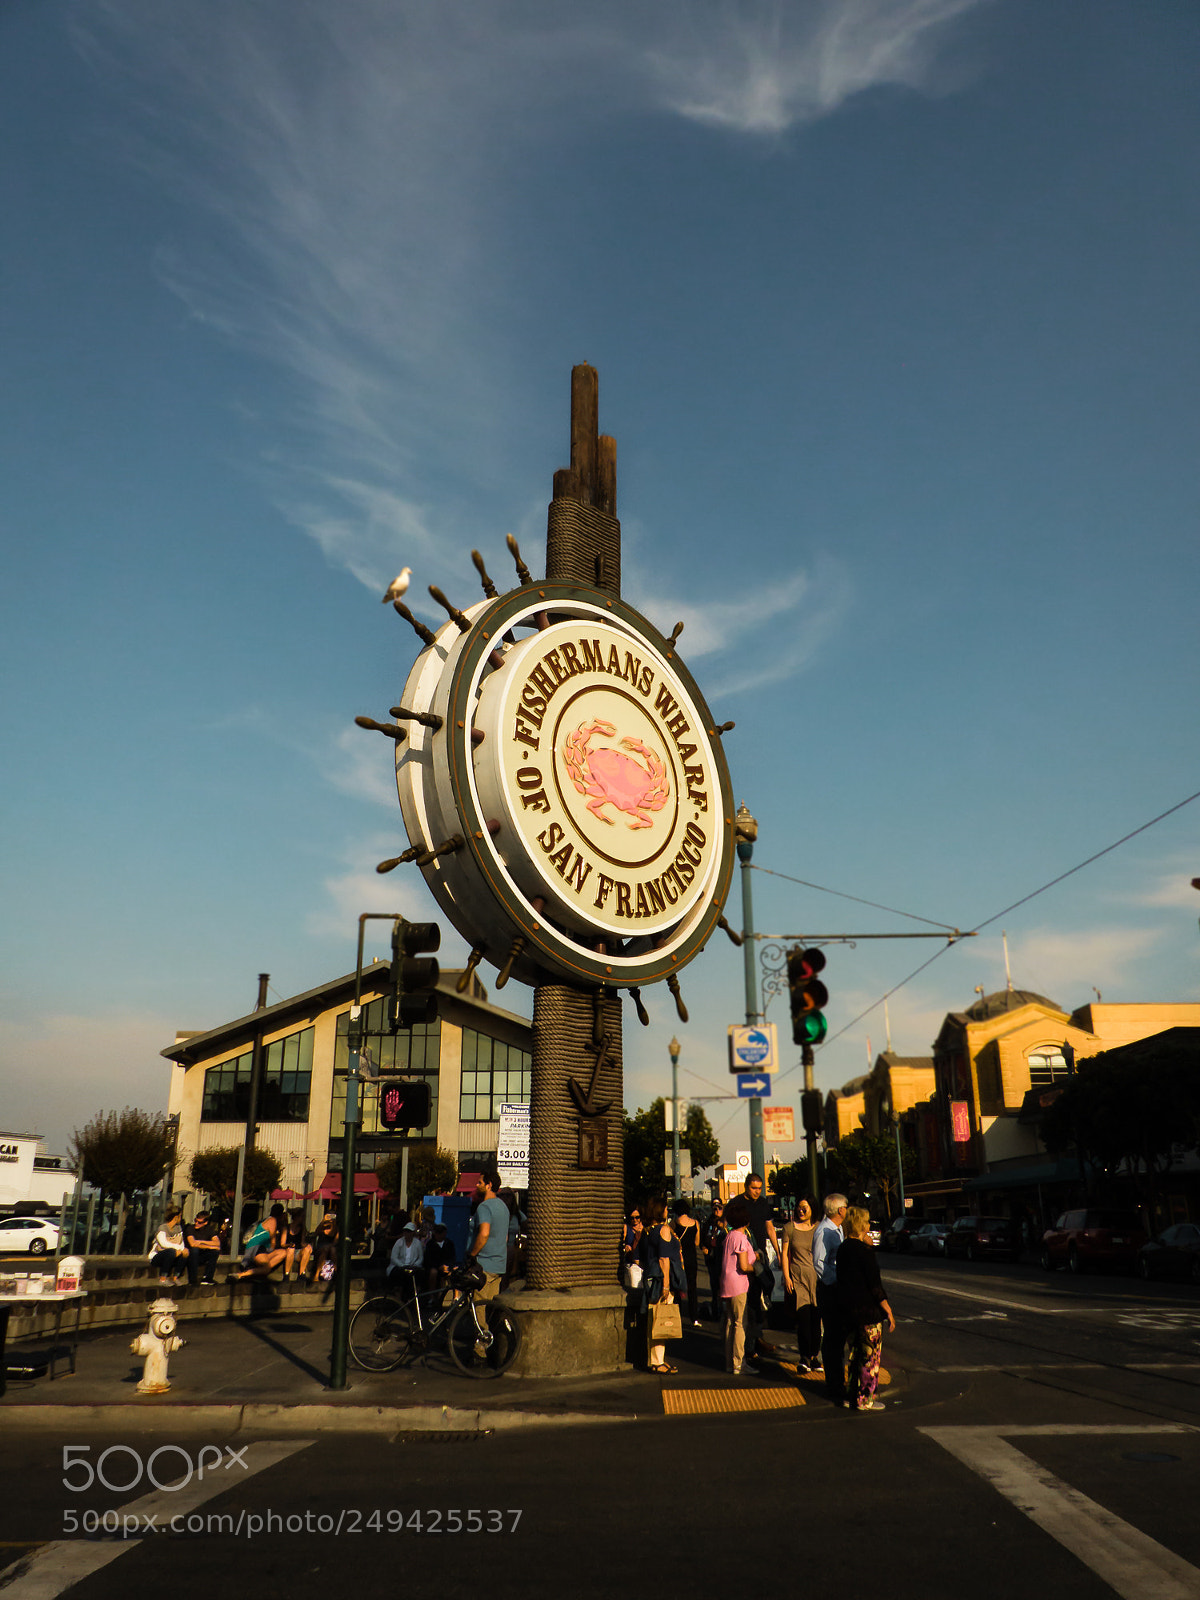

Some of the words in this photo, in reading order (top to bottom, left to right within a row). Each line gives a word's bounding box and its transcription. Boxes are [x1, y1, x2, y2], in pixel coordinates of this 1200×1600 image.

[513, 638, 655, 750] FISHERMANS
[653, 682, 708, 813] WHARF
[516, 766, 550, 814] OF
[536, 821, 593, 895] SAN
[592, 820, 707, 919] FRANCISCO
[500, 1150, 526, 1159] $3.00
